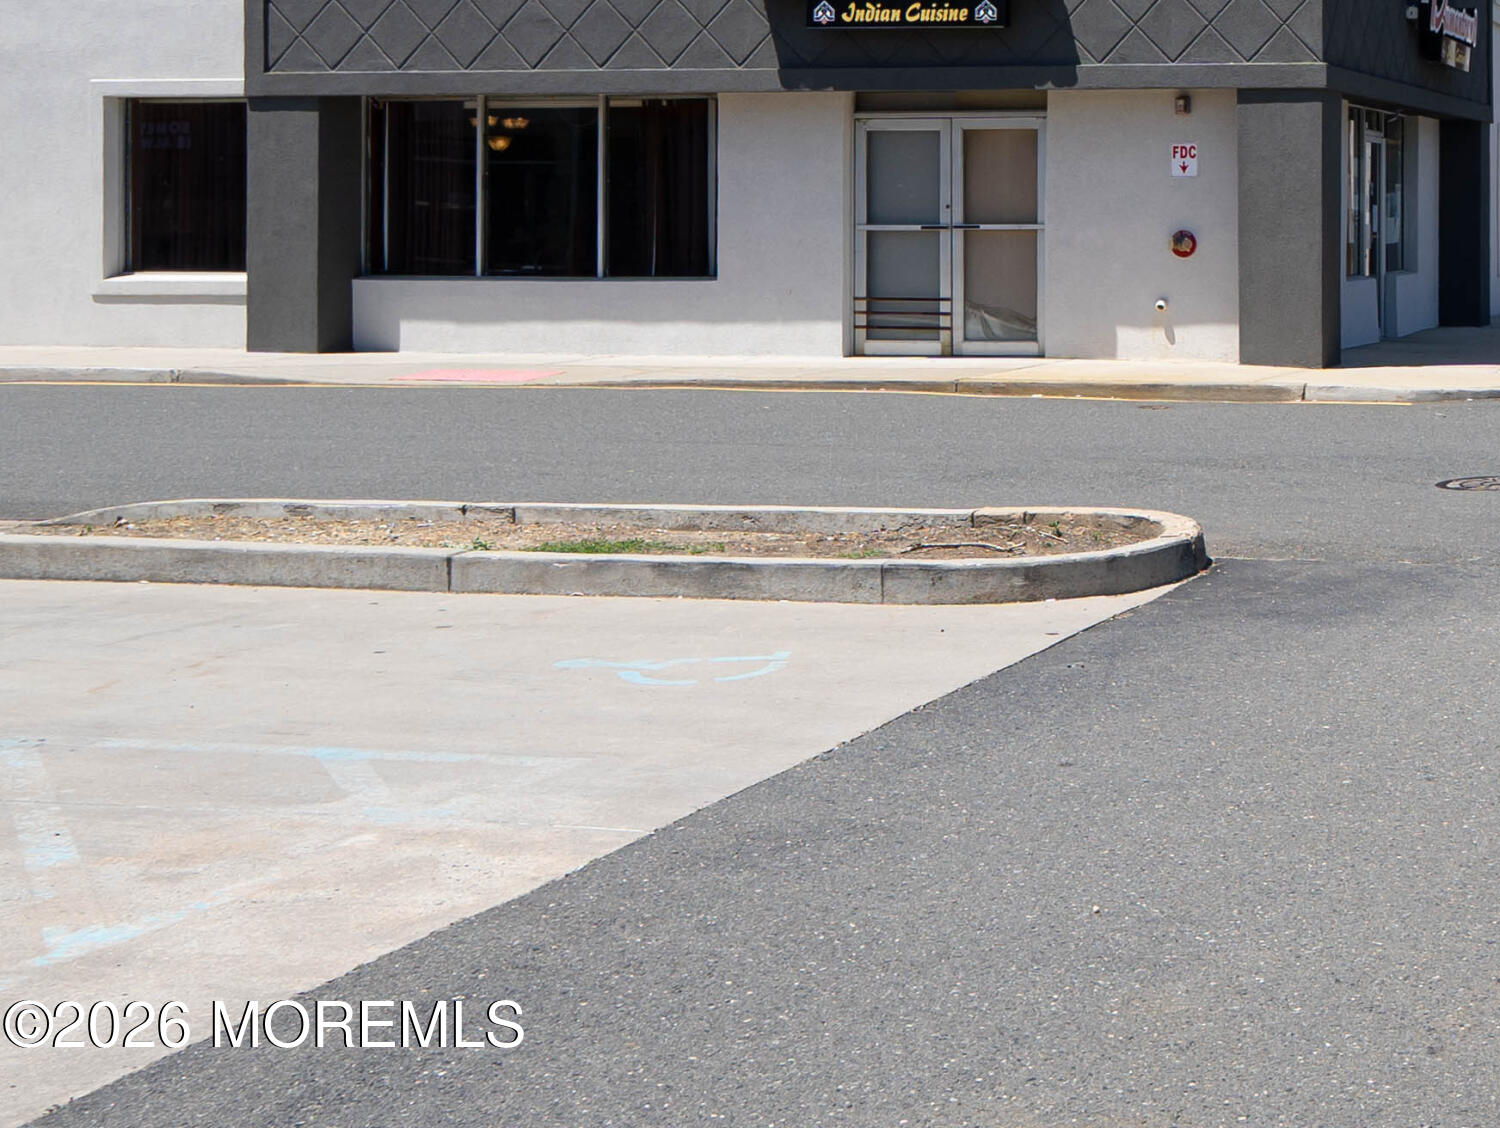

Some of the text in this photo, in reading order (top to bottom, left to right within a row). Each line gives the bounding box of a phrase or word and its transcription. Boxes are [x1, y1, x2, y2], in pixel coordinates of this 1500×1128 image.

[841, 2, 969, 23] Indian Cuisine
[1172, 145, 1197, 159] FDC
